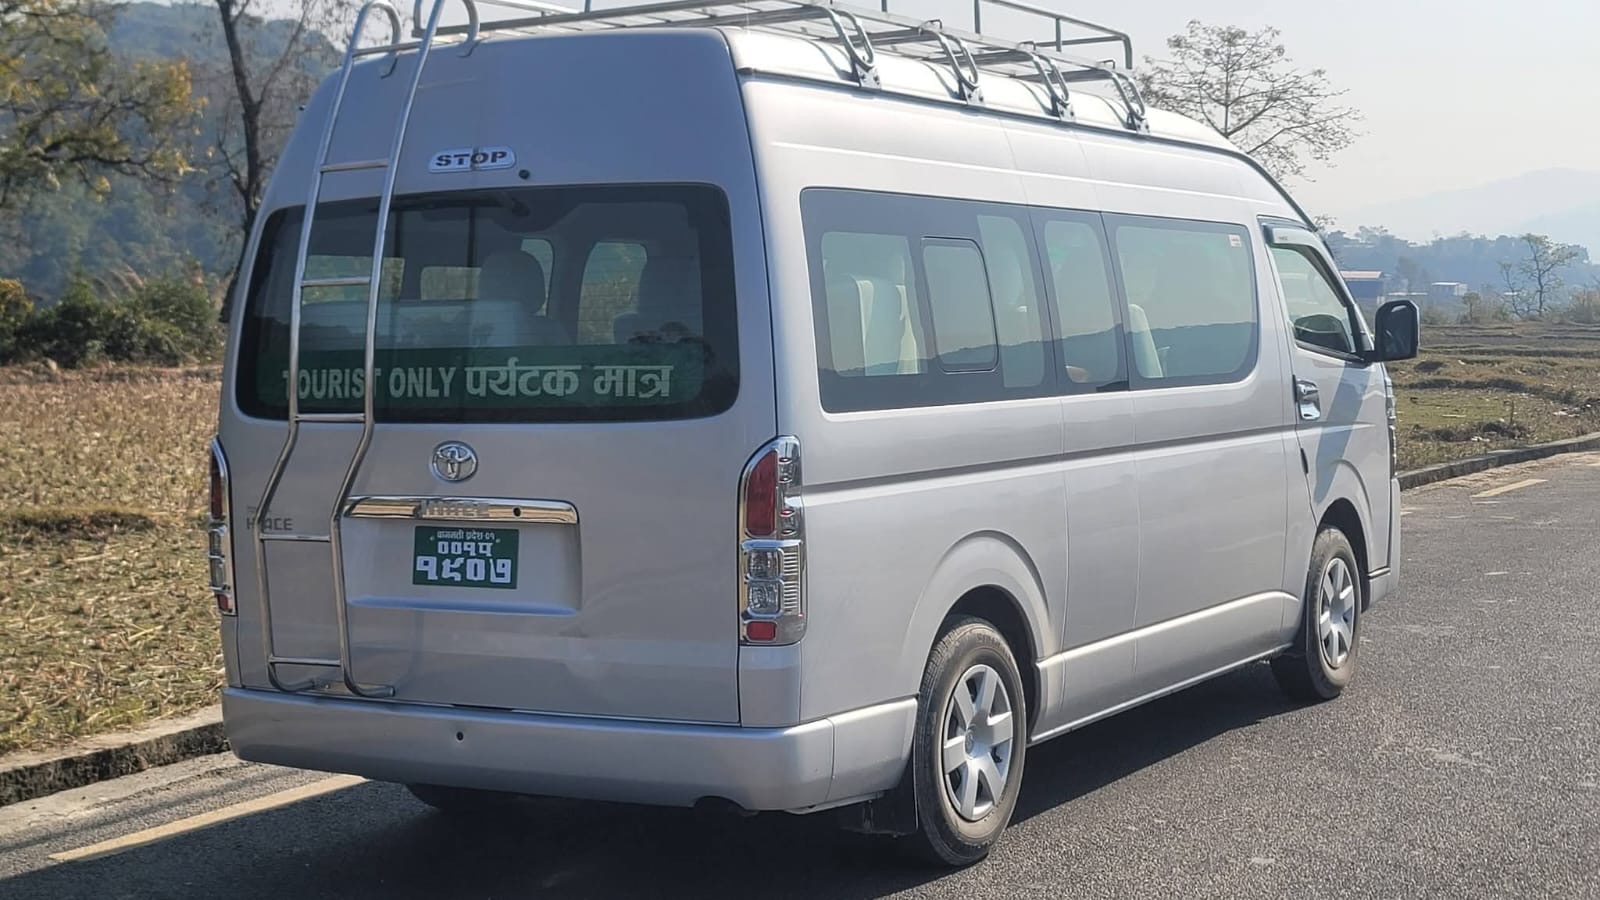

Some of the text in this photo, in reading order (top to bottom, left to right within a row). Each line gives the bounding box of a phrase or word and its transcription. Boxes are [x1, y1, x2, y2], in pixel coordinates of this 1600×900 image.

[435, 151, 507, 166] STOP
[389, 367, 457, 398] ONLY
[464, 357, 674, 398] पर्यटक मात्र
[246, 517, 293, 531] HACE
